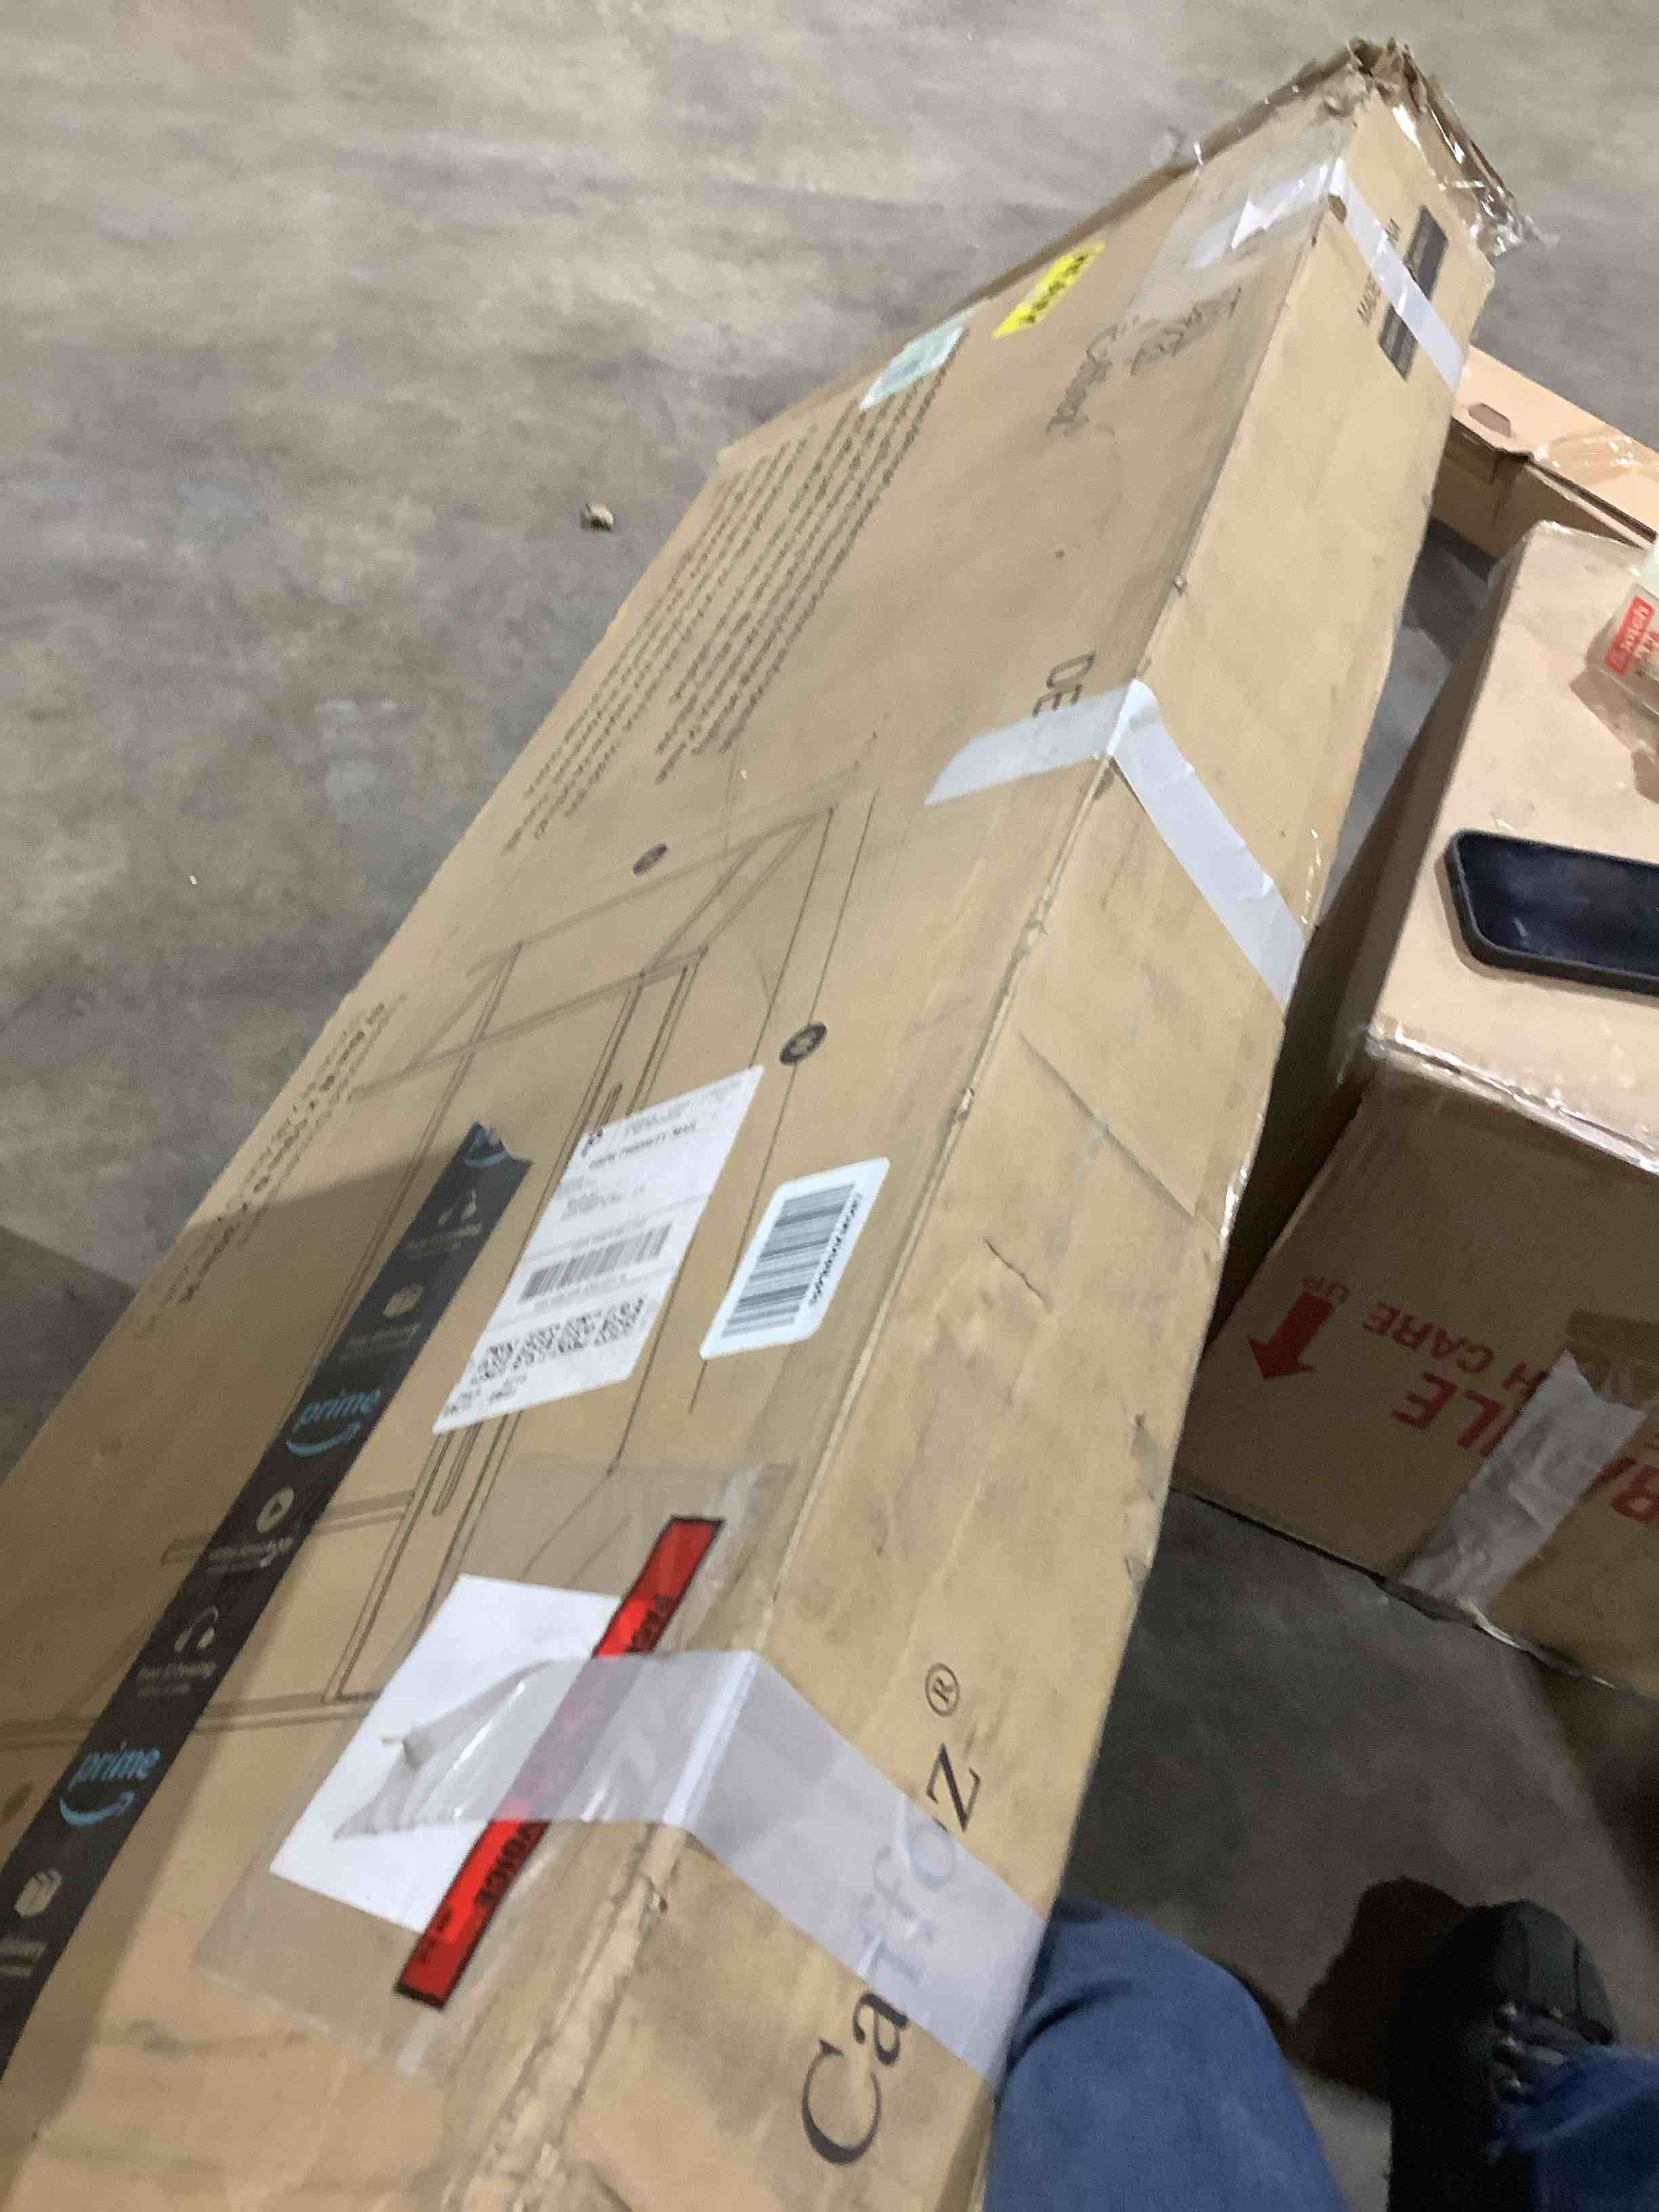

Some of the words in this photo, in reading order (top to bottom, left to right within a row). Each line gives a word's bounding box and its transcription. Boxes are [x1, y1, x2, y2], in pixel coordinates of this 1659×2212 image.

[1362, 1301, 1494, 1373] CARE
[292, 1387, 382, 1433] prime
[68, 1742, 161, 1790] prime
